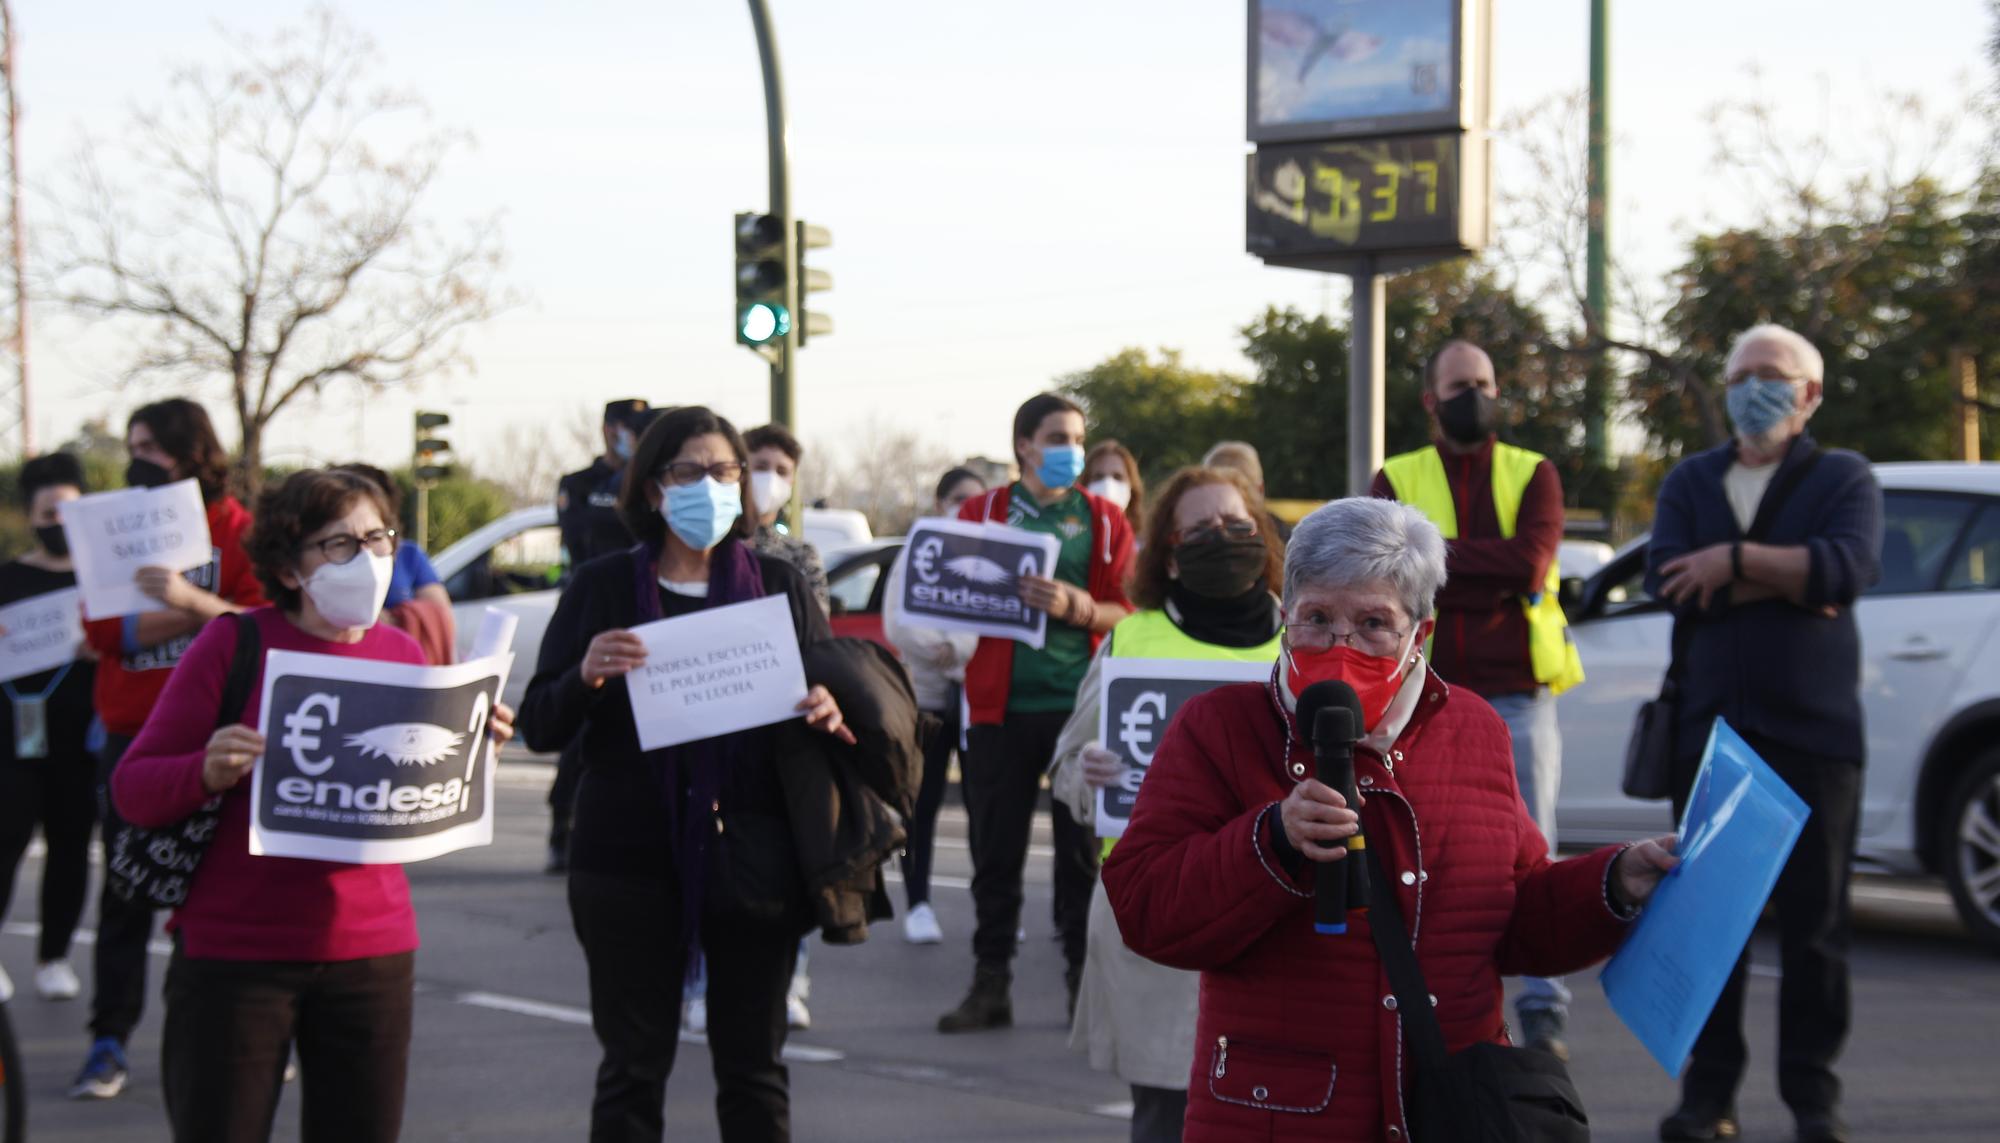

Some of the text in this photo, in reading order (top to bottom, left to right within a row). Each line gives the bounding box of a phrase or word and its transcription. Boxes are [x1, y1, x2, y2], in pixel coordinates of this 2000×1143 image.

[911, 583, 1022, 612] endesa
[650, 680, 667, 695] EL
[683, 681, 754, 706] EN LUCHA
[275, 777, 464, 812] endesa
